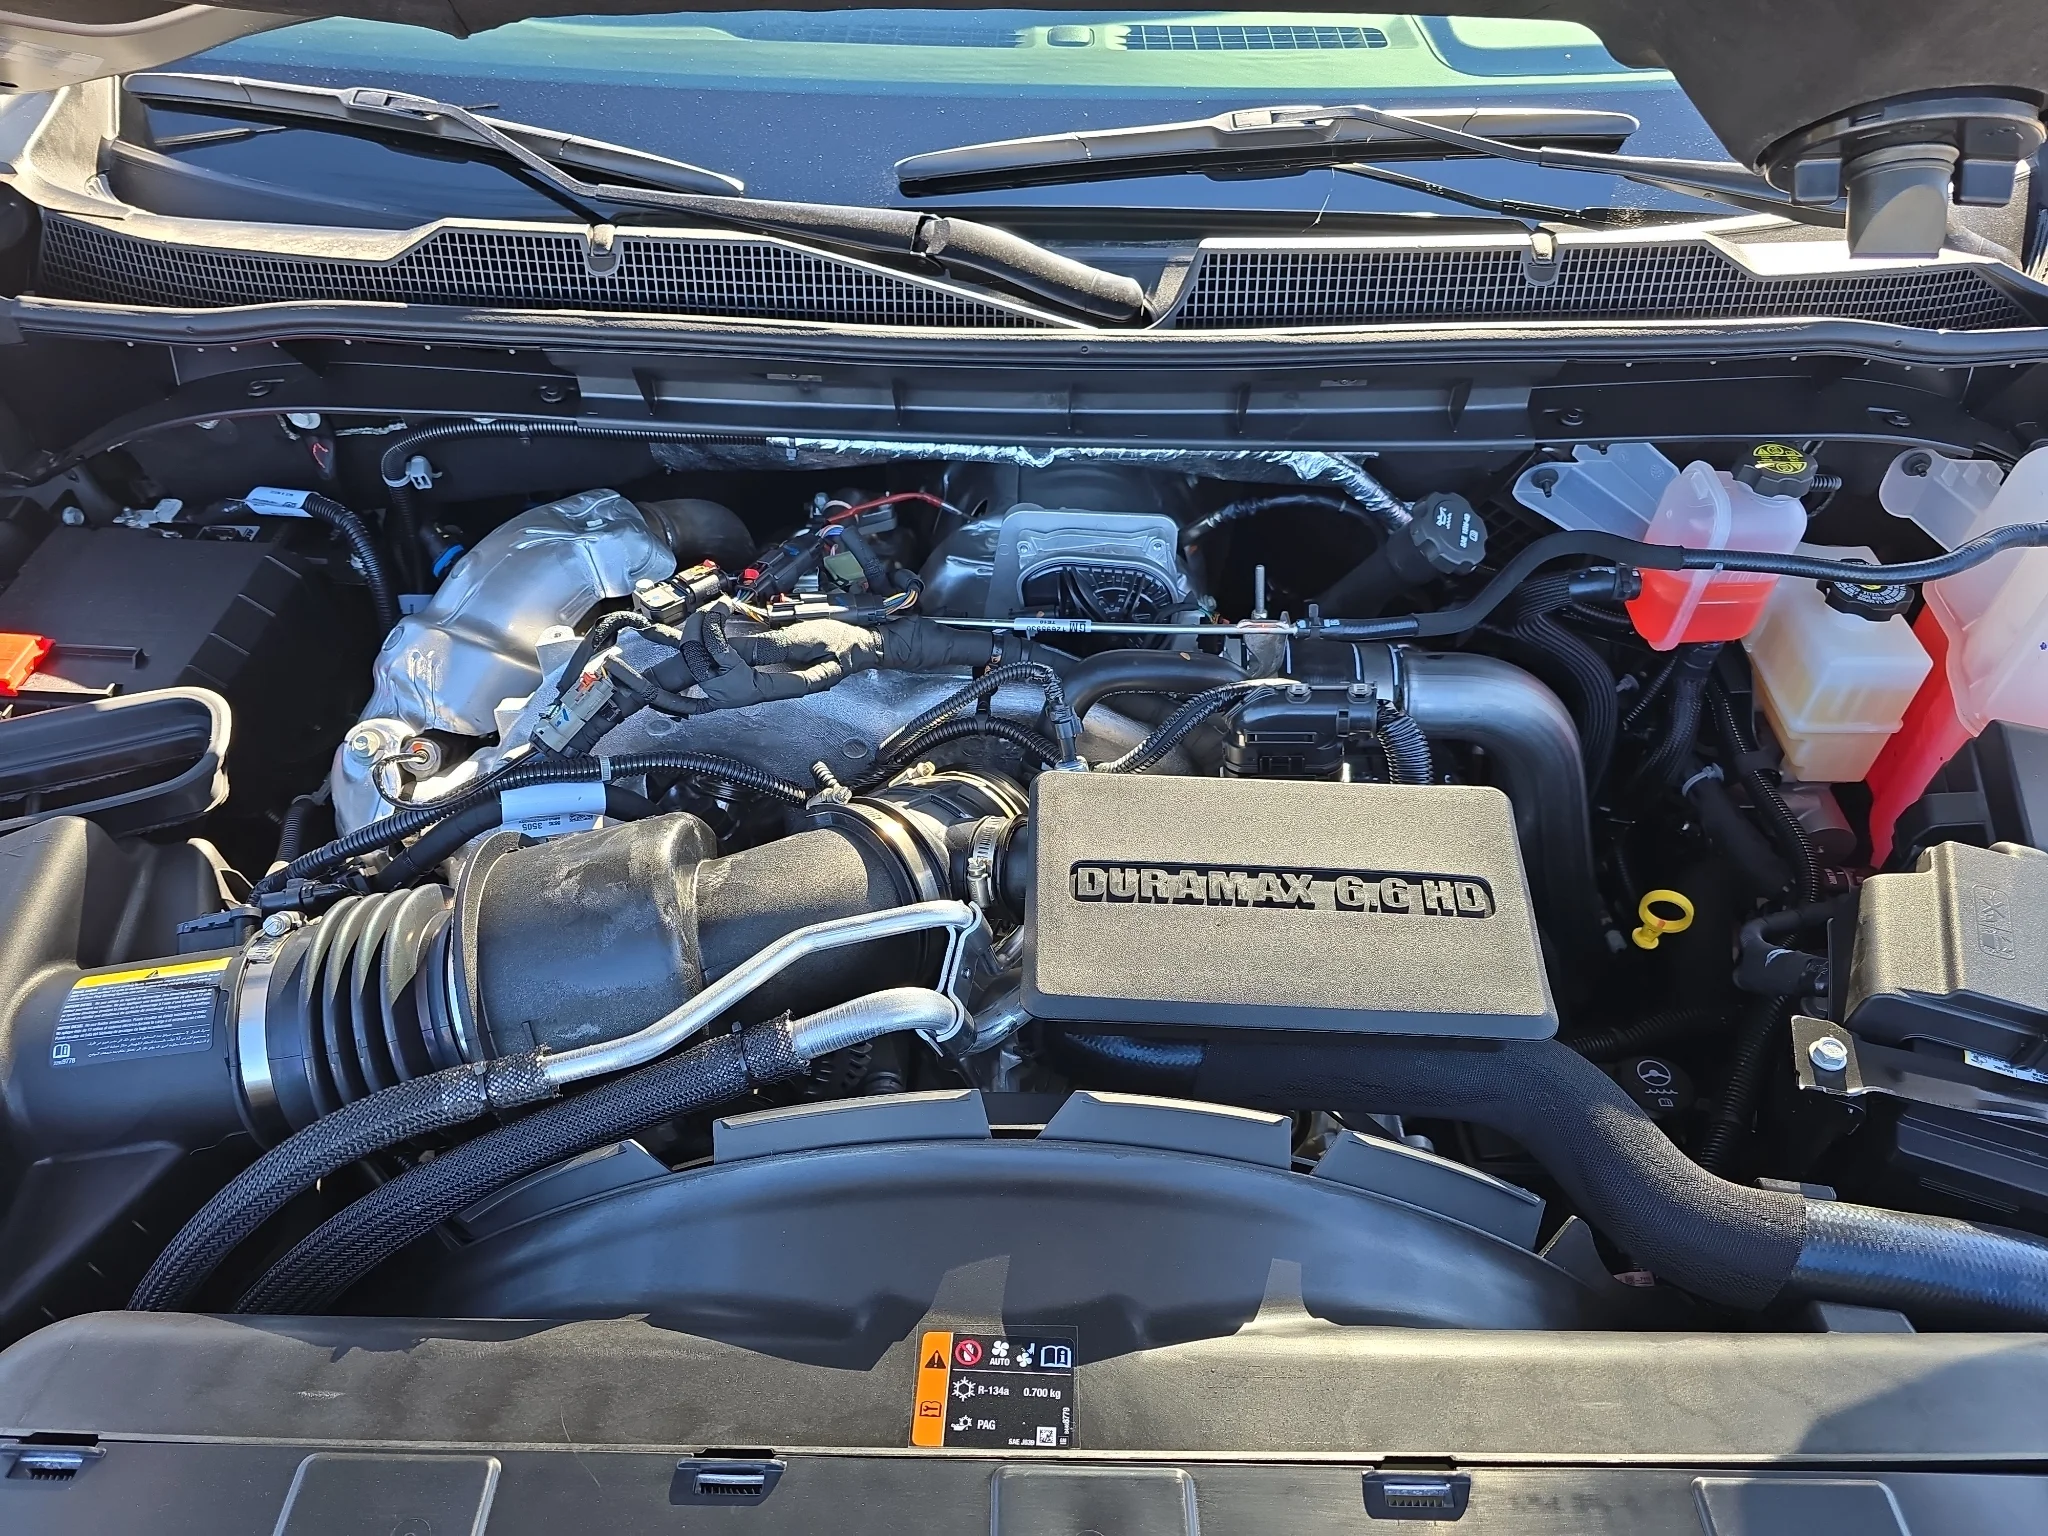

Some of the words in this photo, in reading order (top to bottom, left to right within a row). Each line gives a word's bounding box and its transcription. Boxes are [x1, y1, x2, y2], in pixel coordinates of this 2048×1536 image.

[1460, 535, 1468, 548] SAE
[1070, 621, 1086, 632] GM
[522, 822, 543, 831] 3505
[1075, 866, 1316, 906] DURAMAX
[1335, 875, 1412, 909] 6.6
[1422, 879, 1486, 914] HD
[990, 1357, 1010, 1366] AUTO
[978, 1385, 1010, 1396] R-134a
[1023, 1387, 1048, 1398] 0.700
[1050, 1388, 1062, 1400] kg
[977, 1419, 996, 1431] PAG
